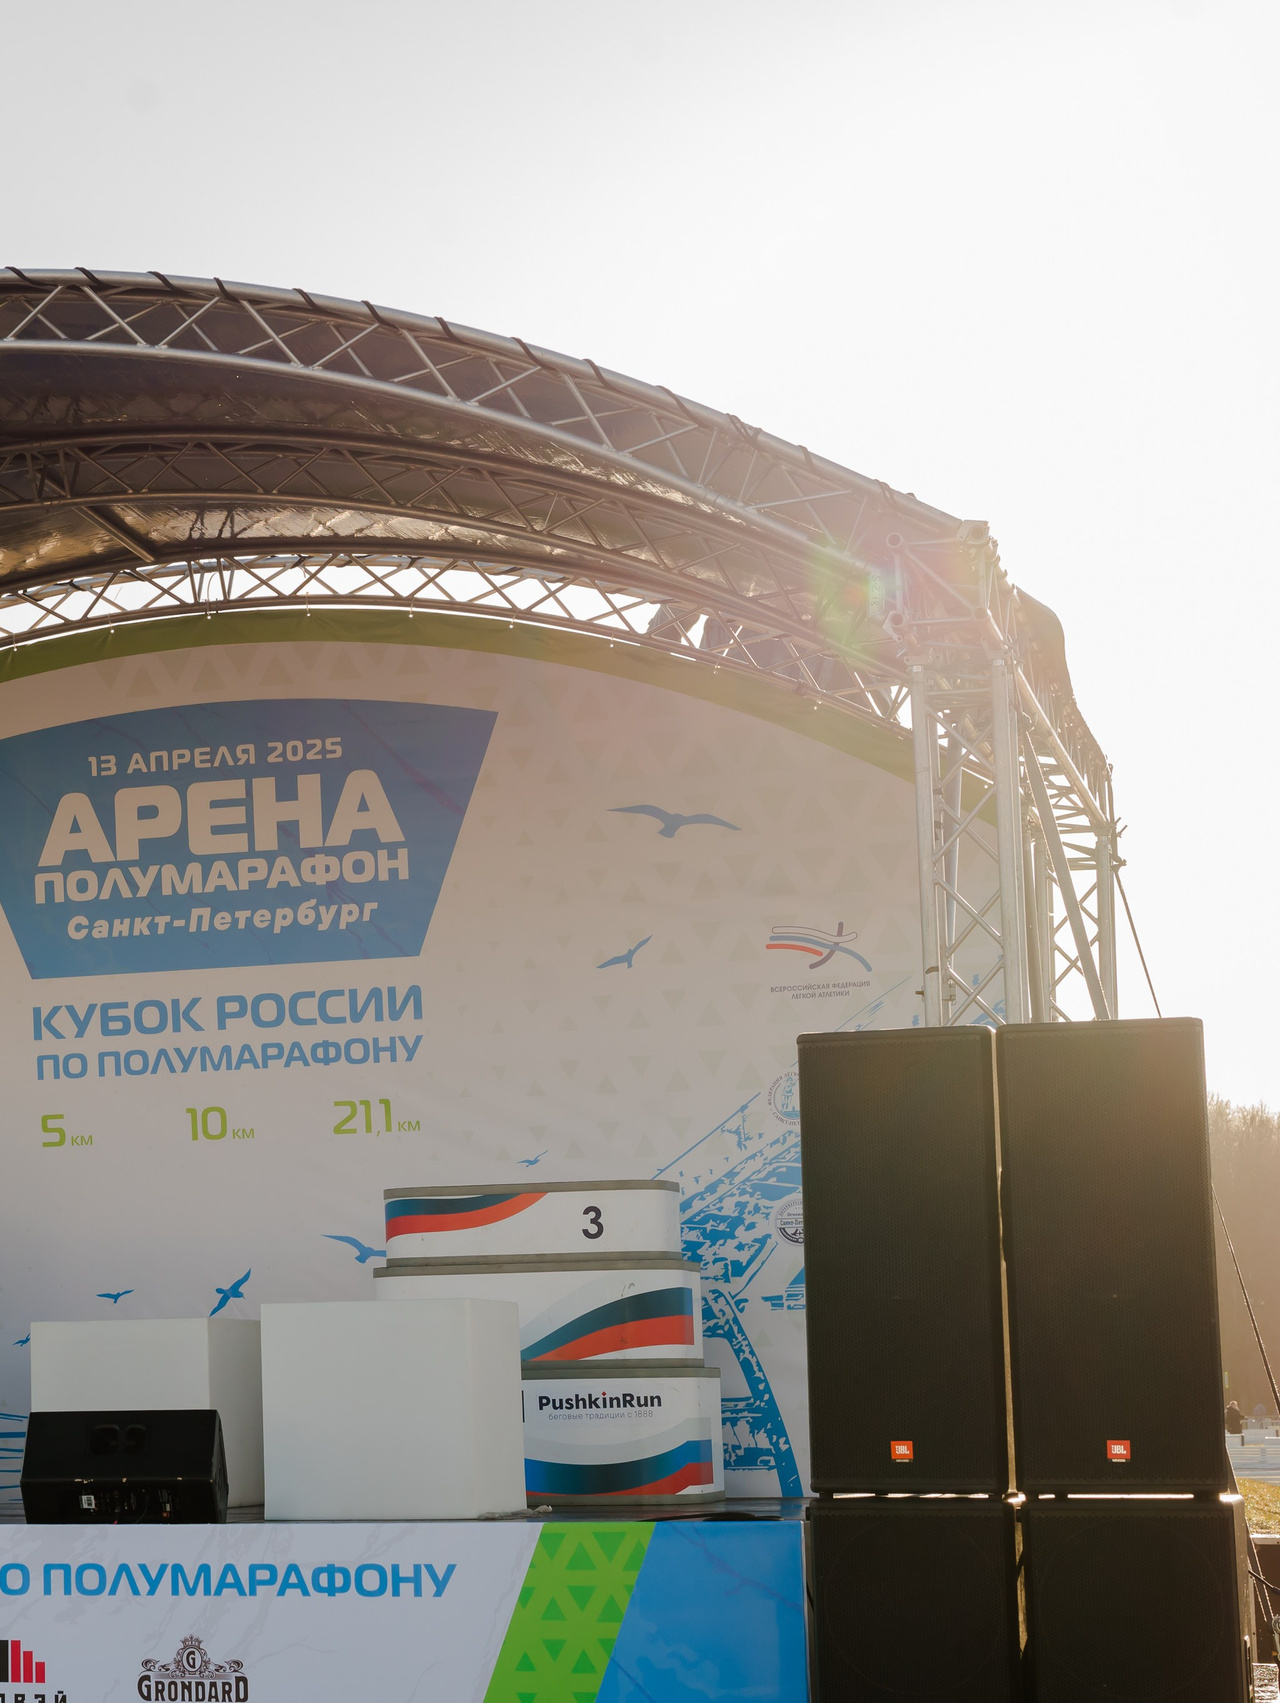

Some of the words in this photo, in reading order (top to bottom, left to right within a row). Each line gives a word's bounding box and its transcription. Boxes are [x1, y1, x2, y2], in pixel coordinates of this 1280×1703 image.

[88, 755, 117, 777] 13
[127, 744, 256, 774] АПРЕЛЯ
[267, 738, 343, 763] 2025
[37, 769, 406, 867] АРЕНА
[35, 848, 410, 904] ПОЛУМАРАФОН
[67, 900, 378, 940] Санкт-Петербург
[770, 983, 830, 993] ВСЕРОССИЙСКАЯ
[831, 981, 870, 989] ФЕДЕРАЦИЯ
[818, 990, 850, 998] АТЛЕТИКИ
[32, 997, 205, 1041] КУБОК
[216, 985, 424, 1031] РОССИИ
[36, 1053, 88, 1081] ПО
[98, 1035, 424, 1078] ПОЛУМАРАФОНУ
[41, 1113, 67, 1147] 5
[186, 1106, 228, 1141] 10
[333, 1098, 393, 1137] 21,1
[581, 1205, 605, 1240] 3
[538, 1391, 662, 1411] PushkinRun
[548, 1412, 583, 1420] беговые
[585, 1411, 625, 1421] традиции
[634, 1410, 654, 1418] 1888
[895, 1445, 910, 1454] JBL
[1111, 1444, 1127, 1455] JBL
[43, 1563, 458, 1598] ПОЛУМАРАФОНУ
[186, 1650, 197, 1669] G
[137, 1674, 249, 1703] GRONDARD
